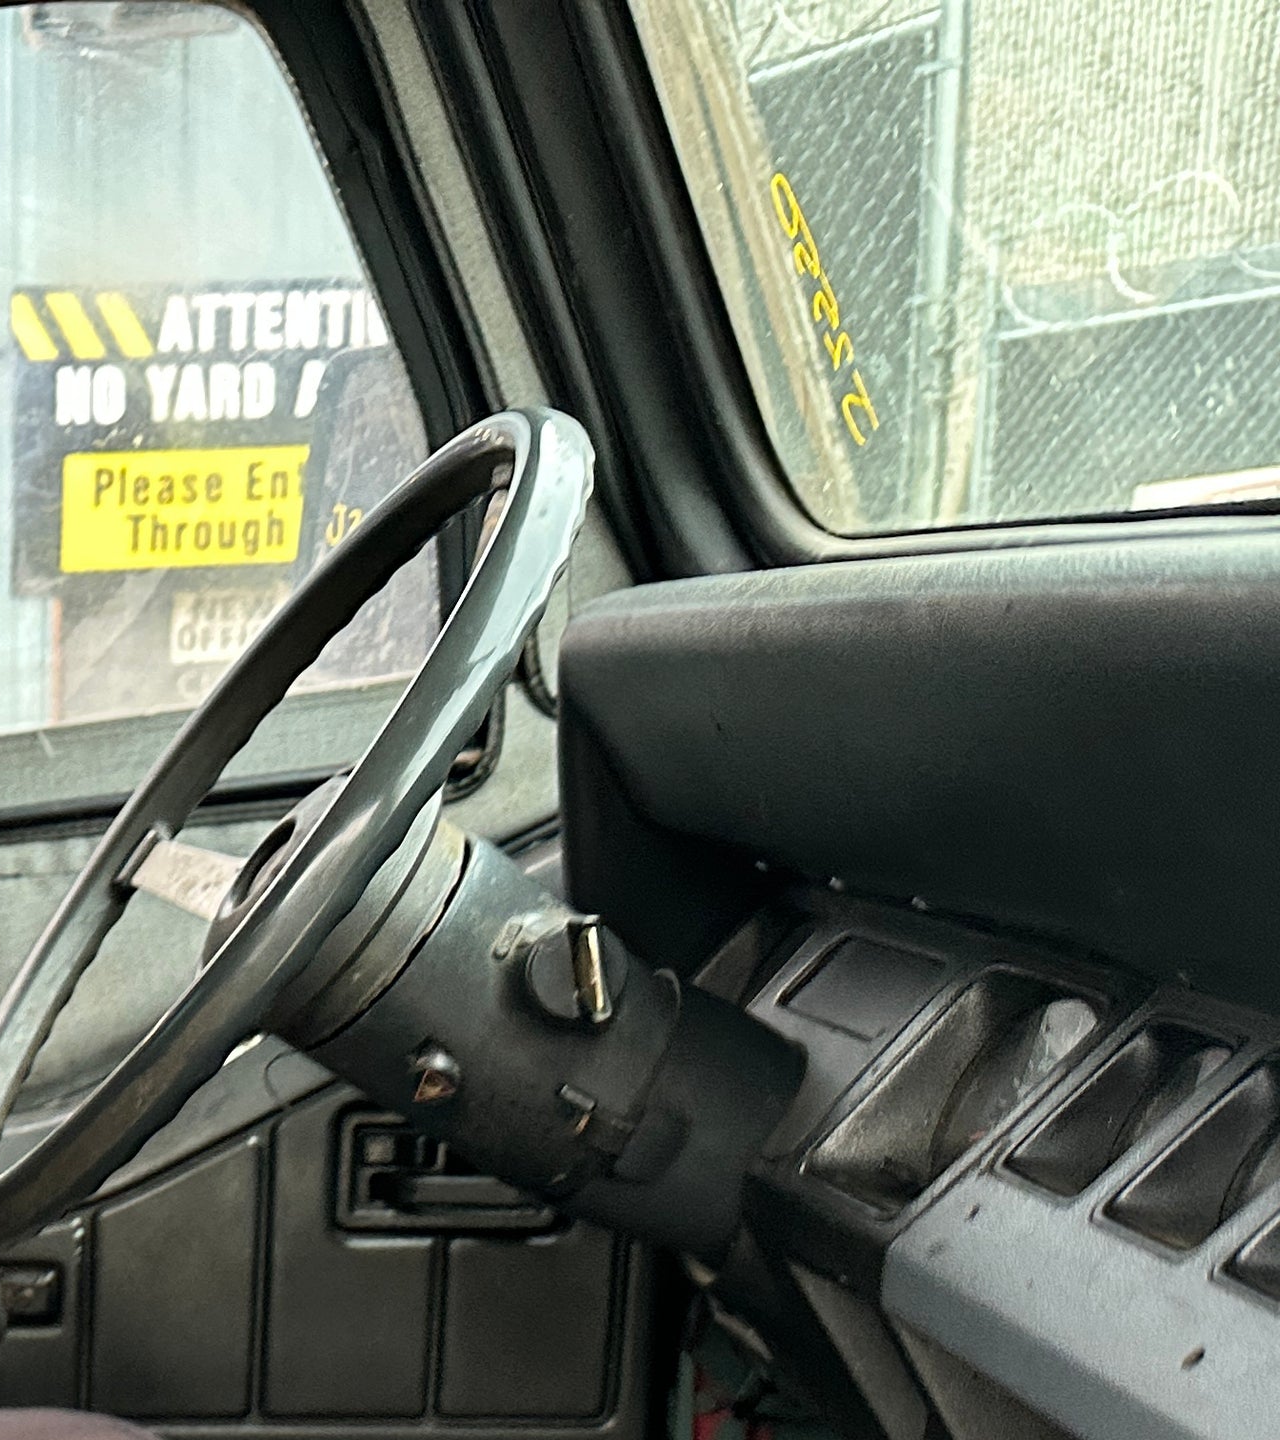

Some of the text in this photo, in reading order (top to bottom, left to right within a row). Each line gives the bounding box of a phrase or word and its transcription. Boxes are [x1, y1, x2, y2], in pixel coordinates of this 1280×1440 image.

[55, 364, 127, 426] NO
[145, 360, 276, 423] YARD
[94, 467, 224, 508] Please
[127, 511, 285, 557] Through
